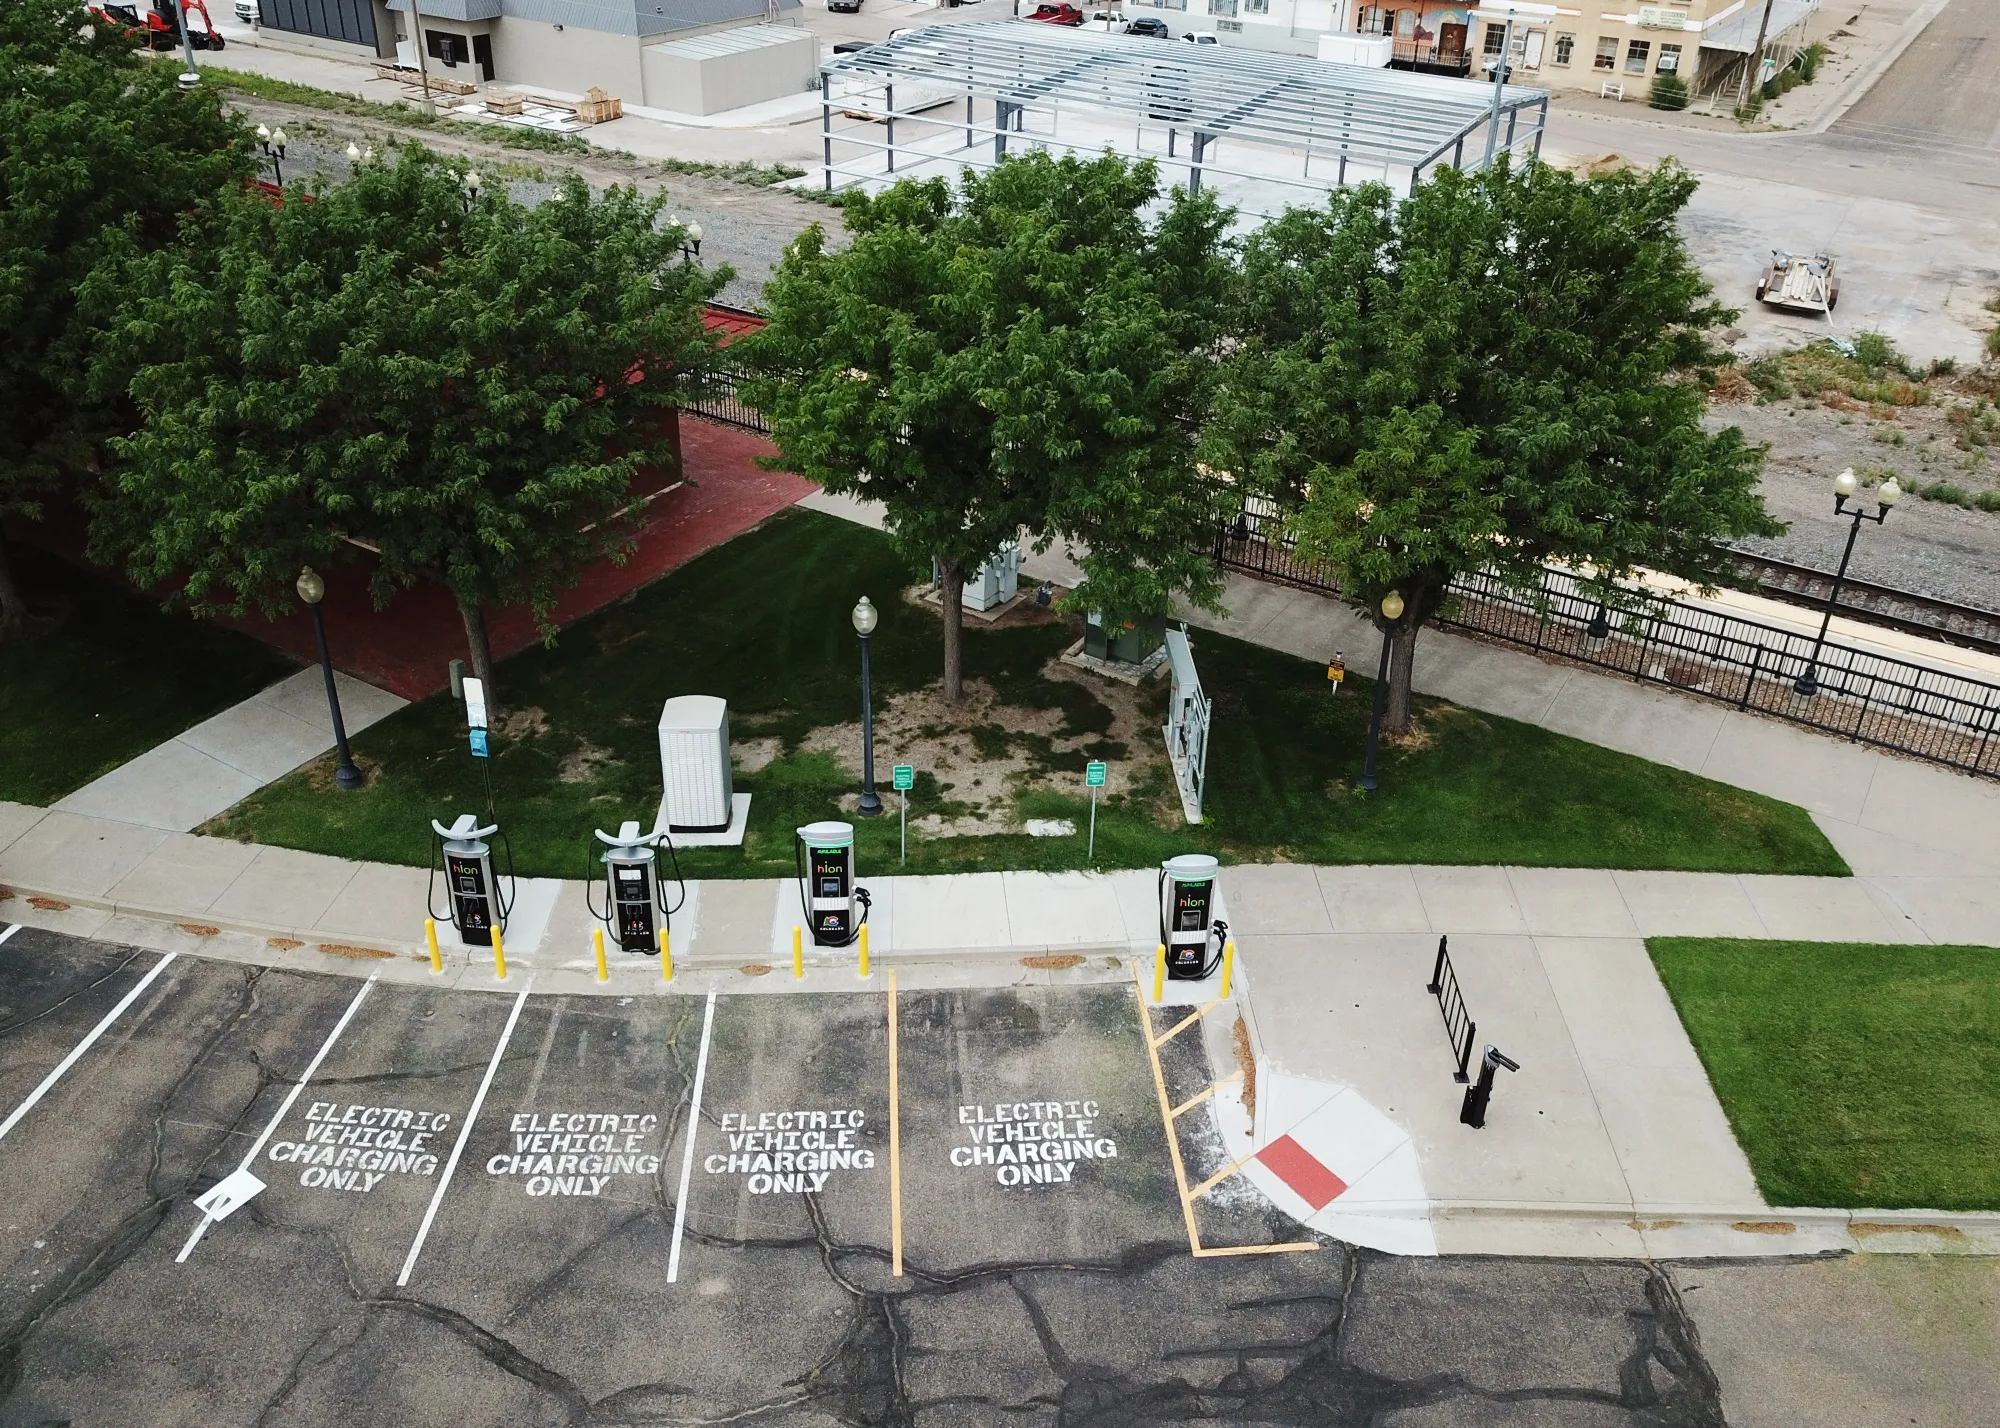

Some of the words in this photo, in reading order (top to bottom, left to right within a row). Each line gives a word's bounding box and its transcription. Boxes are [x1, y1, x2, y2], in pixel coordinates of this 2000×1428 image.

[817, 860, 843, 873] hion
[1179, 893, 1205, 907] hion
[305, 1102, 450, 1131] ELECTRIC
[510, 1114, 657, 1132] ELECTRIC
[721, 1110, 865, 1131] ELECTRIC
[959, 1100, 1100, 1124] ELECTRIC
[305, 1123, 433, 1152] VEHICLE
[729, 1130, 855, 1151] VEHICLE
[969, 1120, 1095, 1143] VEHICLE
[516, 1134, 644, 1153] VEHICLE
[950, 1139, 1117, 1167] CHARGING
[269, 1142, 438, 1175] CHARGING
[486, 1155, 659, 1174] CHARGING
[704, 1150, 874, 1173] CHARGING
[300, 1167, 386, 1192] ONLY
[747, 1171, 830, 1194] ONLY
[997, 1162, 1075, 1186] ONLY
[526, 1176, 611, 1196] ONLY
